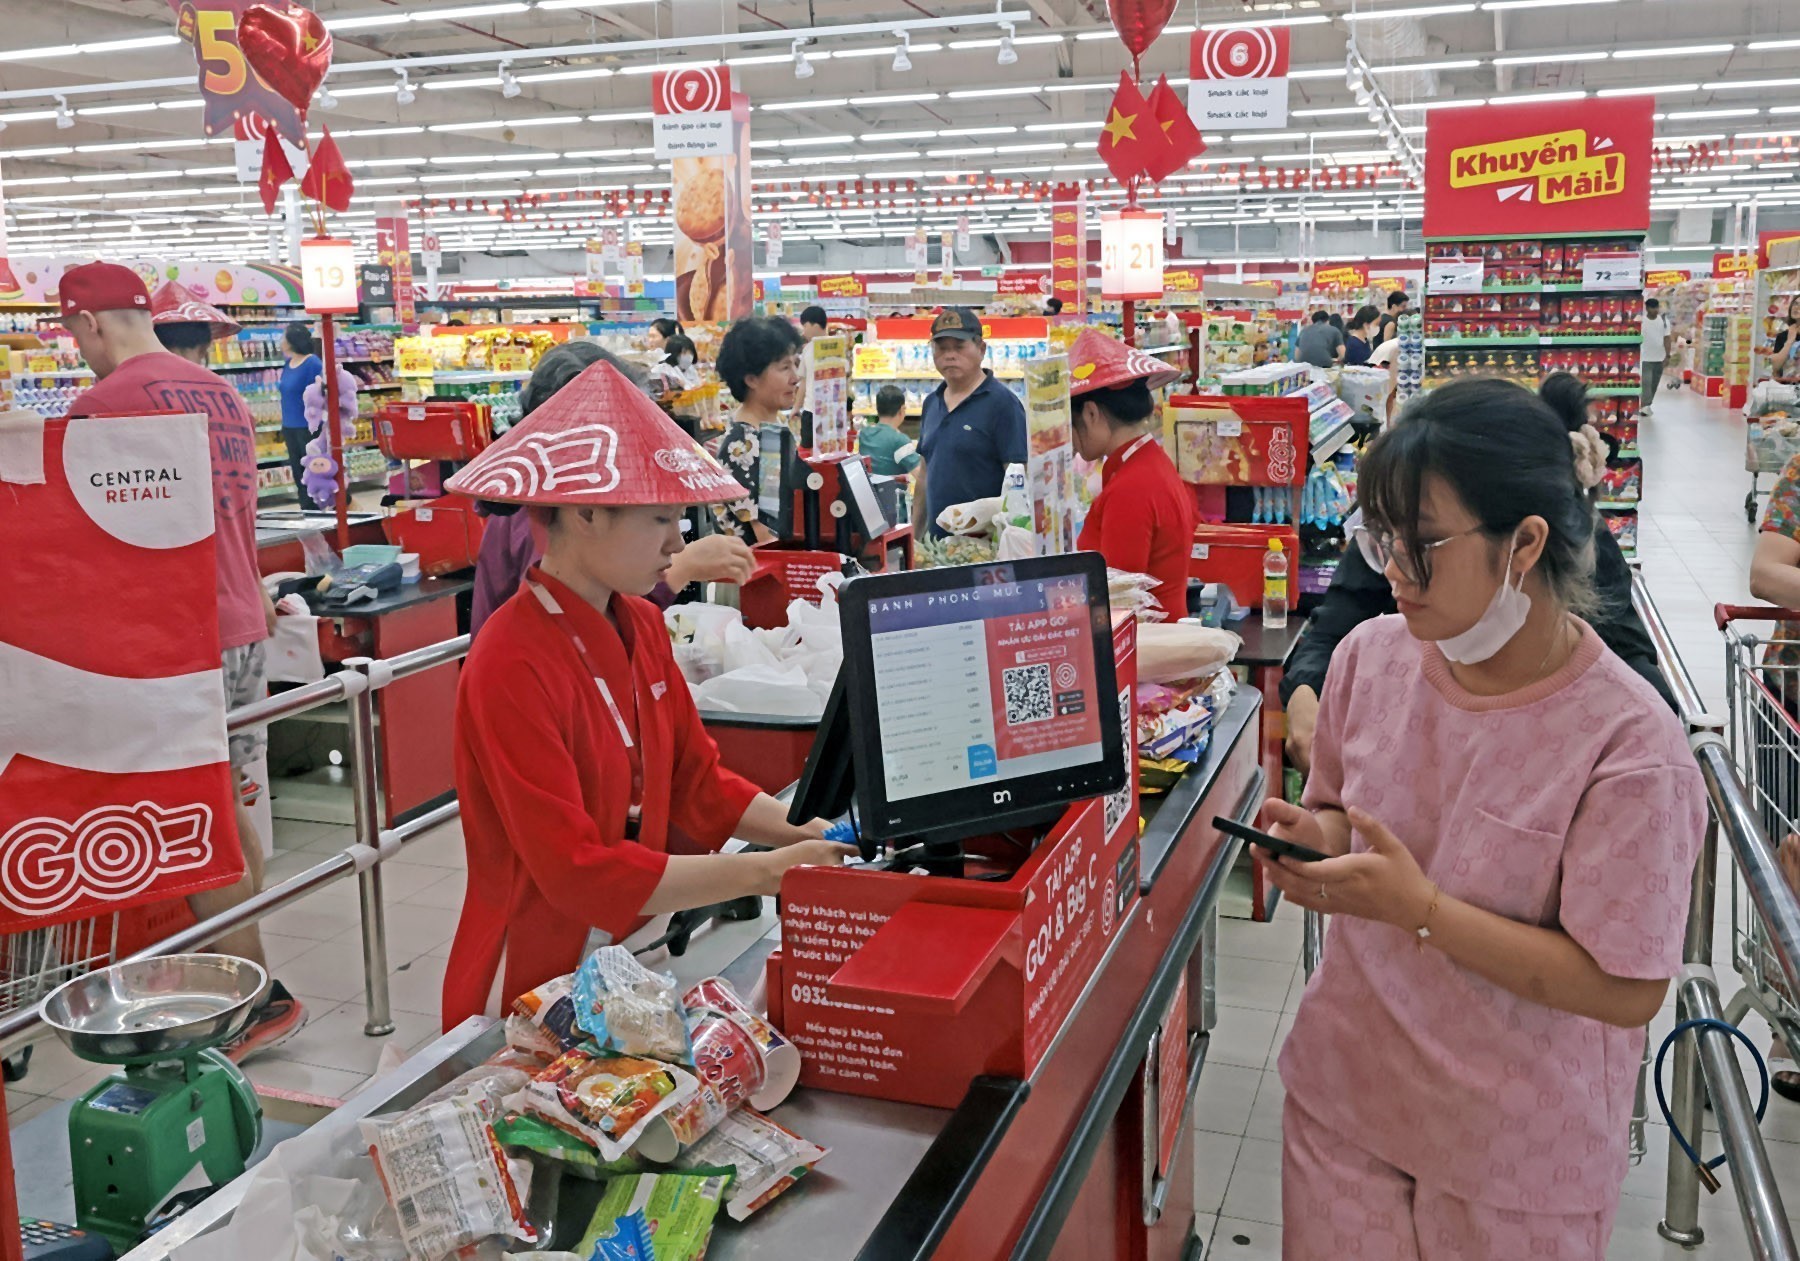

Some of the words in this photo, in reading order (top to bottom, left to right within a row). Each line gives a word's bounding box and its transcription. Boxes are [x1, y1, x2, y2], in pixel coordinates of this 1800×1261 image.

[1229, 42, 1249, 67] 6
[684, 81, 699, 102] 7
[1456, 138, 1578, 178] Khuyến
[1546, 156, 1618, 199] Mãi!
[1130, 243, 1154, 269] 21
[315, 266, 344, 288] 19
[160, 388, 242, 421] COSTA
[90, 467, 182, 487] CENTRAL
[106, 486, 172, 504] RETAIL
[928, 590, 980, 606] PHONG
[787, 902, 810, 916] Quý
[813, 905, 847, 919] khách
[849, 911, 867, 921] vui
[1026, 914, 1052, 982] GO!
[1055, 901, 1064, 941] &
[1066, 876, 1086, 924] Big
[1088, 853, 1098, 890] C
[832, 938, 848, 949] tra
[825, 951, 842, 962] khi
[806, 1021, 826, 1033] Nếu
[851, 1027, 883, 1040] khách
[819, 1051, 834, 1061] khi
[837, 1053, 867, 1066] thanh
[819, 1064, 836, 1075] Xin
